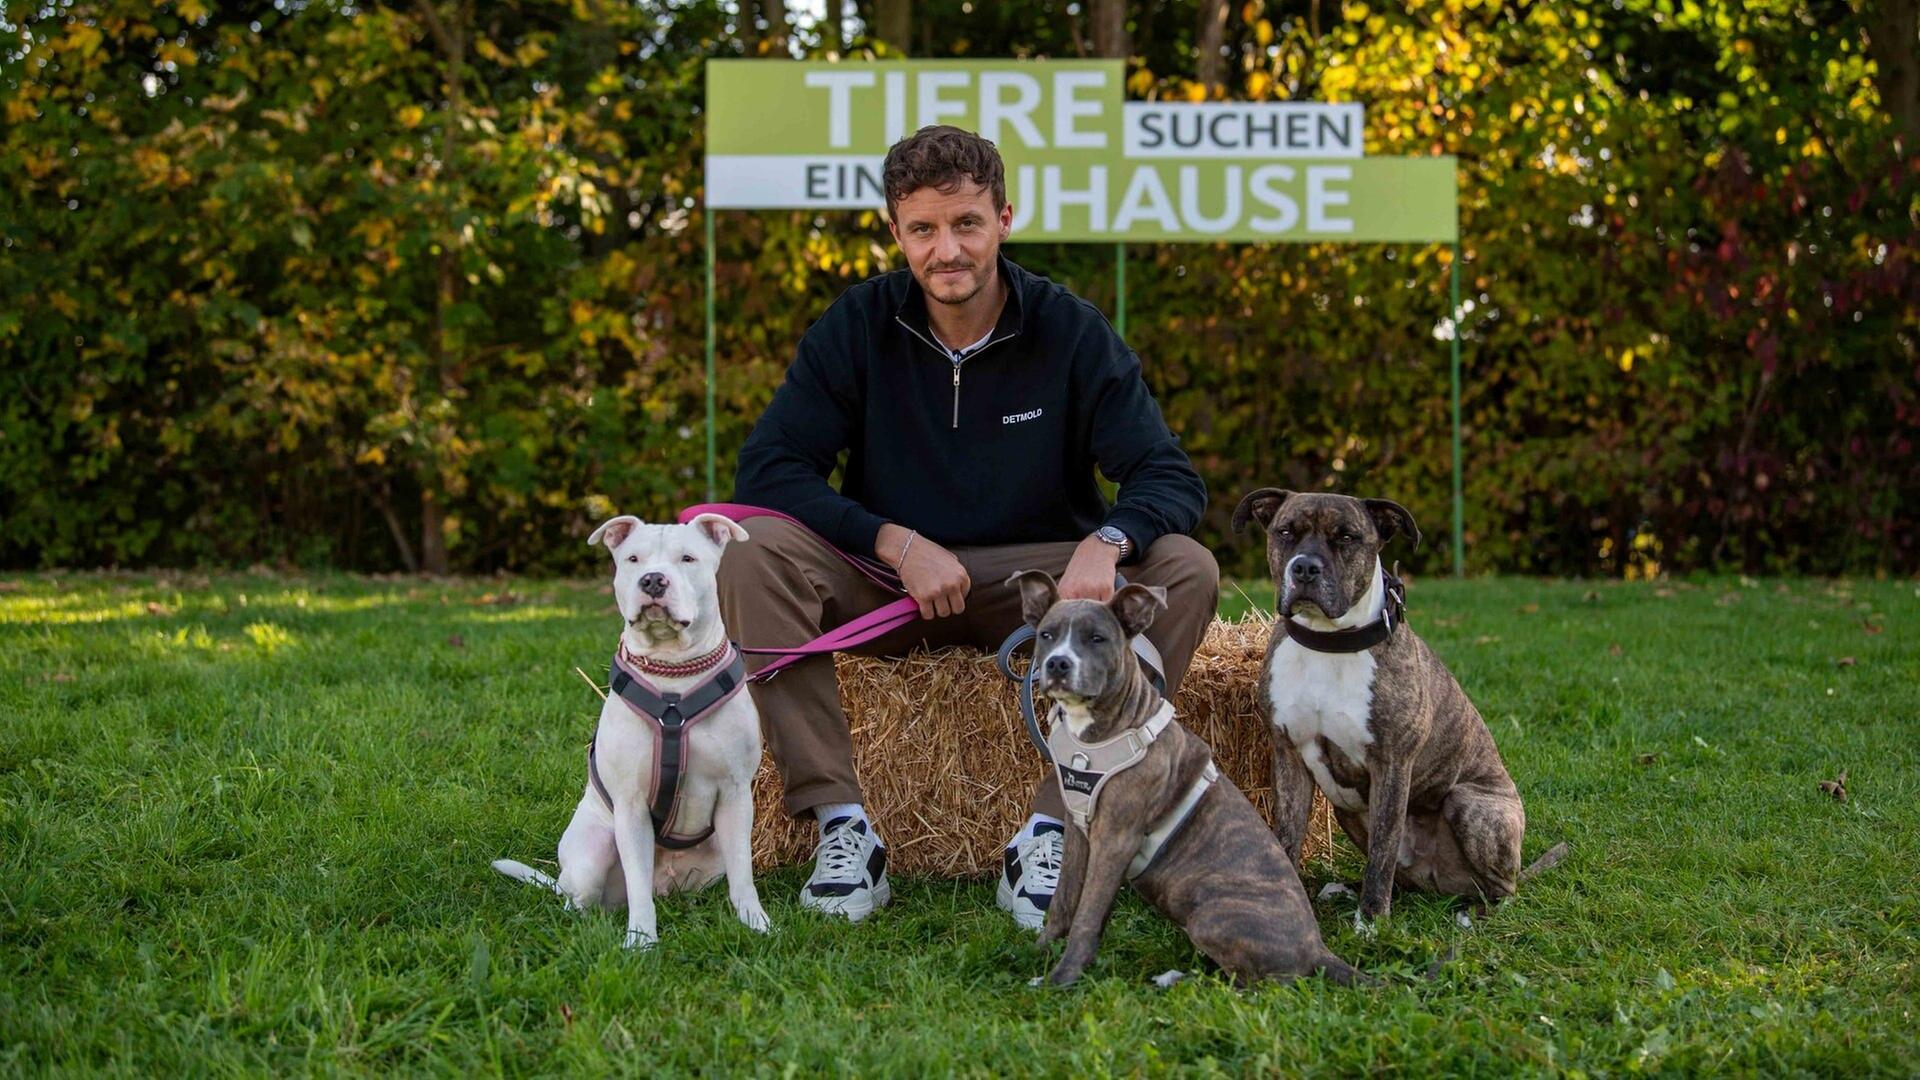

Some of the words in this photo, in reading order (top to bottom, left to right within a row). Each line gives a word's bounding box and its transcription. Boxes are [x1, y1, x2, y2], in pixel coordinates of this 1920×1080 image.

[805, 71, 1107, 148] TIERE
[1138, 112, 1352, 148] SUCHEN
[1011, 165, 1354, 234] HAUSE
[1002, 408, 1043, 424] DETMOLD
